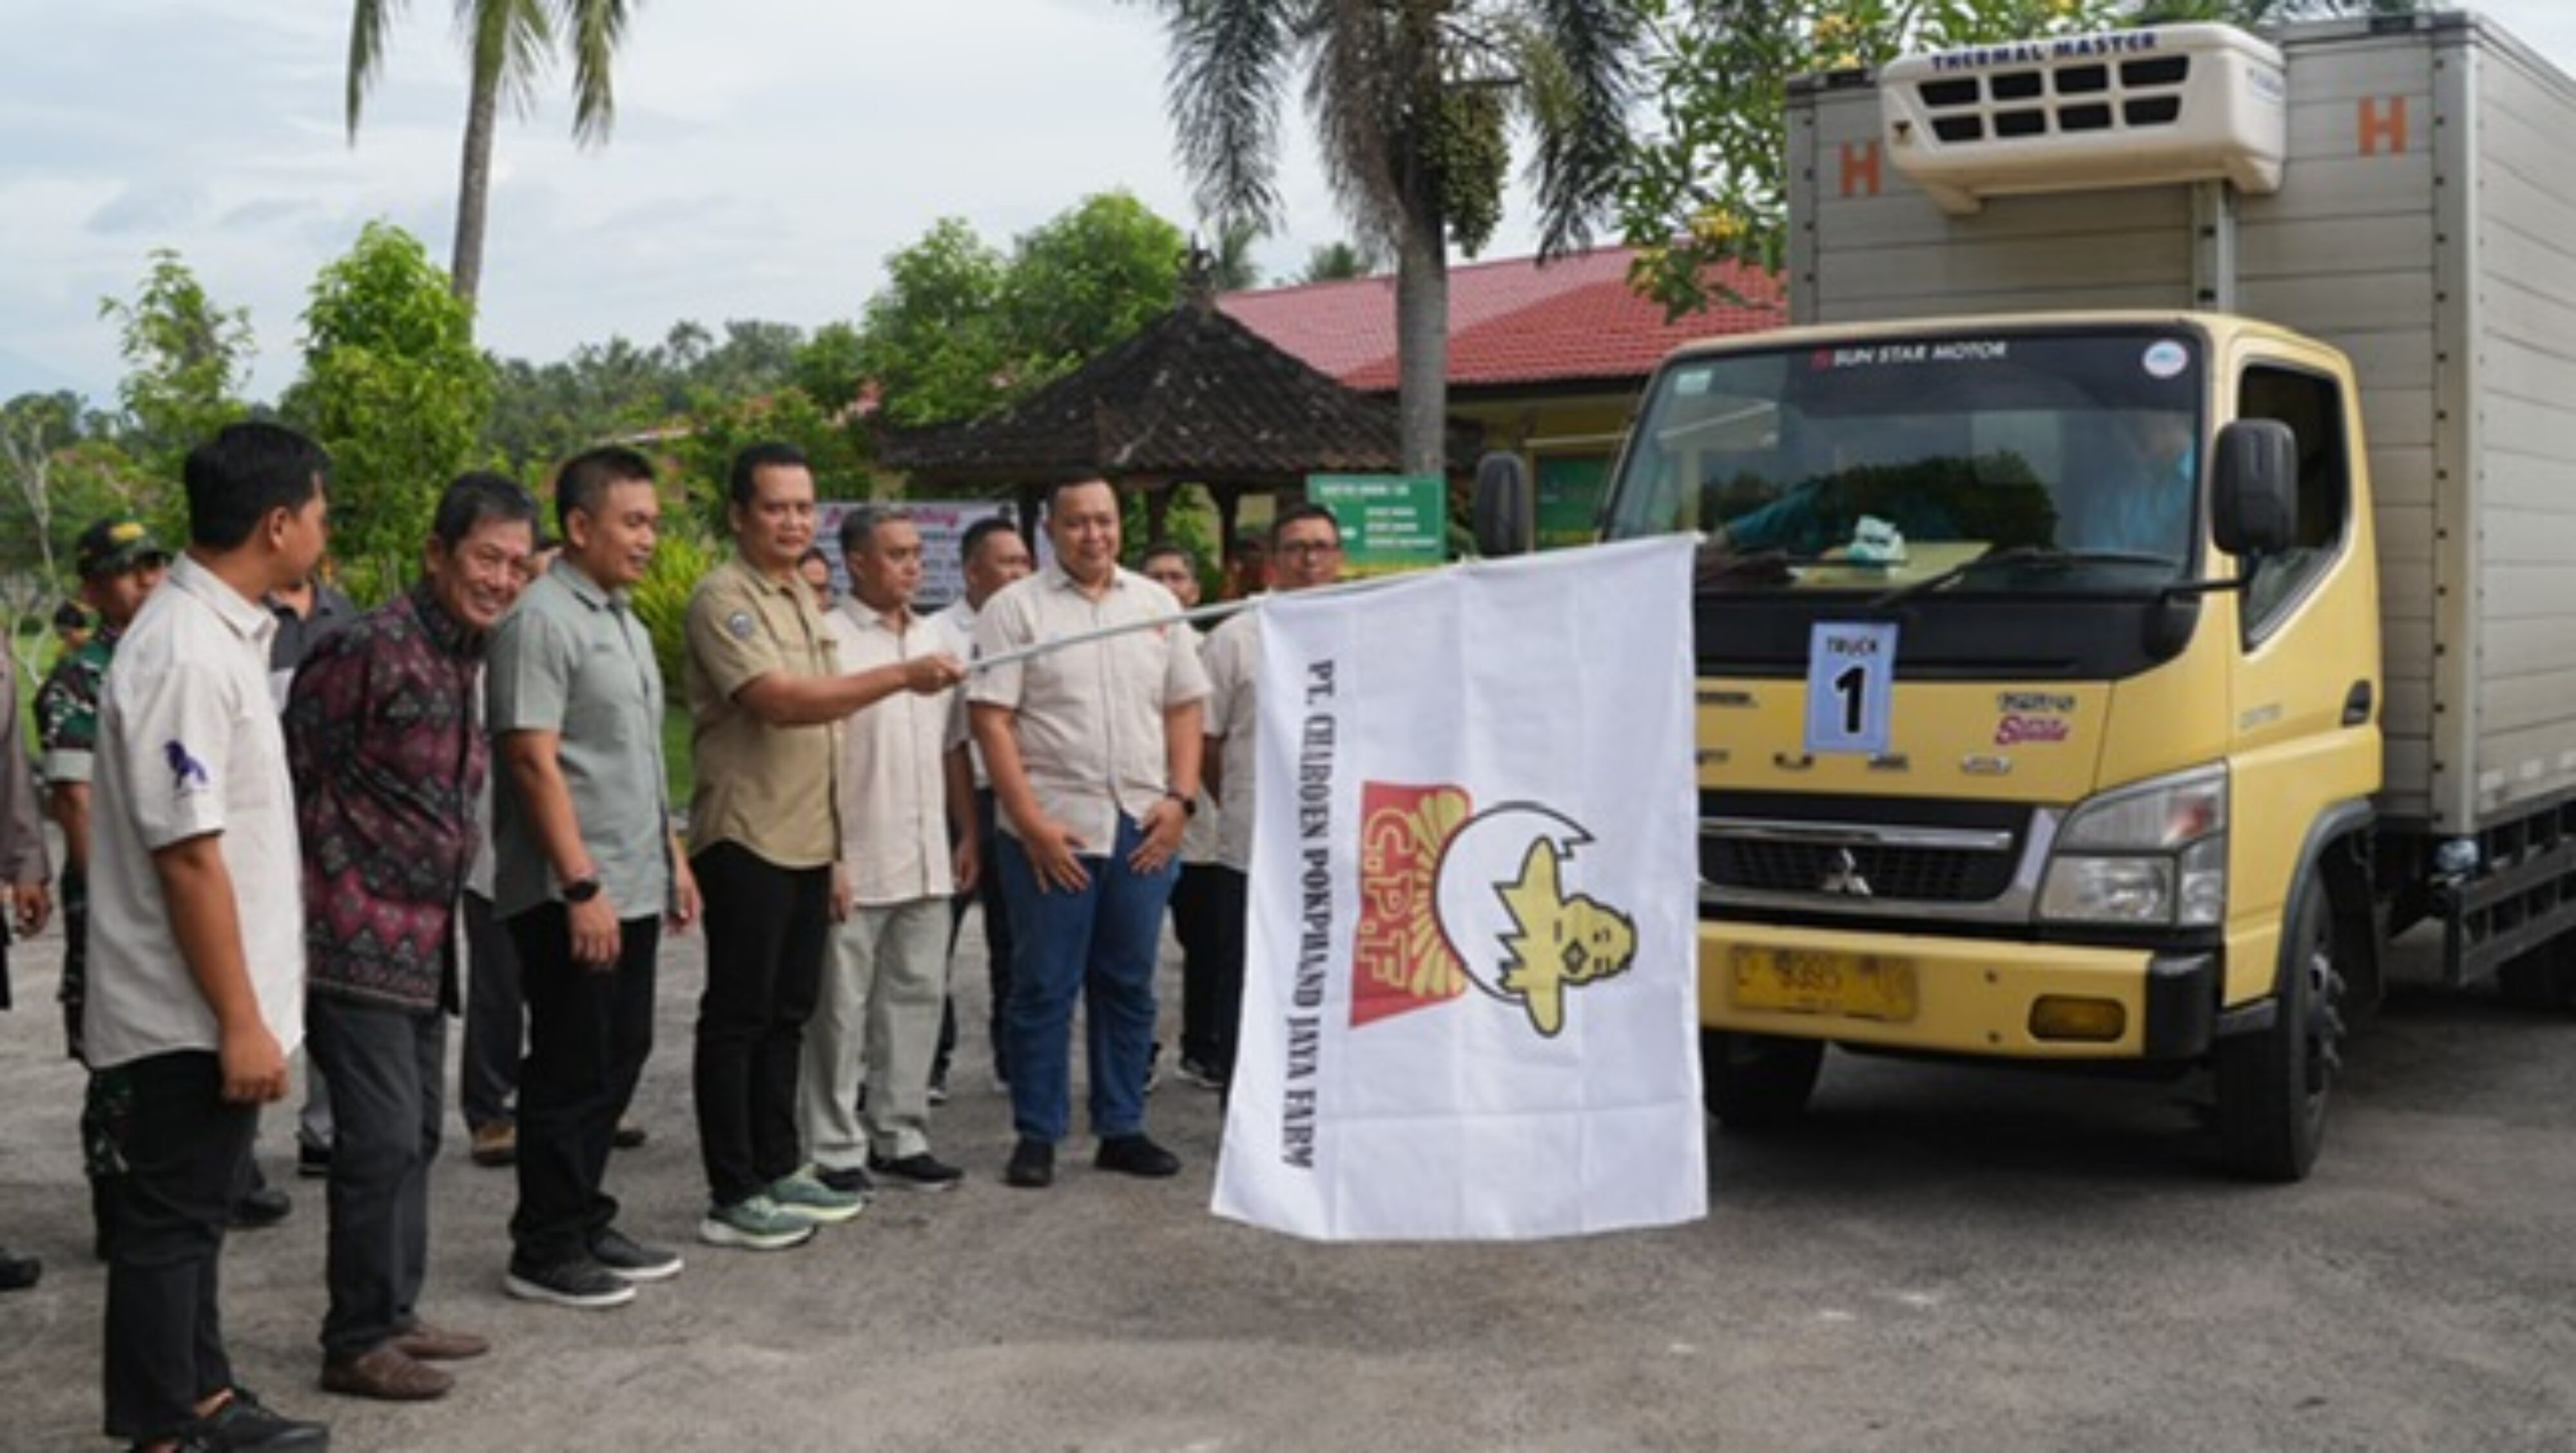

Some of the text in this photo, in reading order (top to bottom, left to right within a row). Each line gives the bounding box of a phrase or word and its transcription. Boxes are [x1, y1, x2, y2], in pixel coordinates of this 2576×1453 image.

[1932, 31, 2155, 71] THERMAL MASTER
[2358, 95, 2406, 157] H
[1840, 141, 1882, 196] H
[1833, 340, 2008, 367] SUN STAR MOTOR
[1826, 636, 1878, 655] TRUCK
[1835, 666, 1864, 733] 1
[1281, 660, 1337, 1170] PT. CHAROEN POKPHAND JAYA FARM
